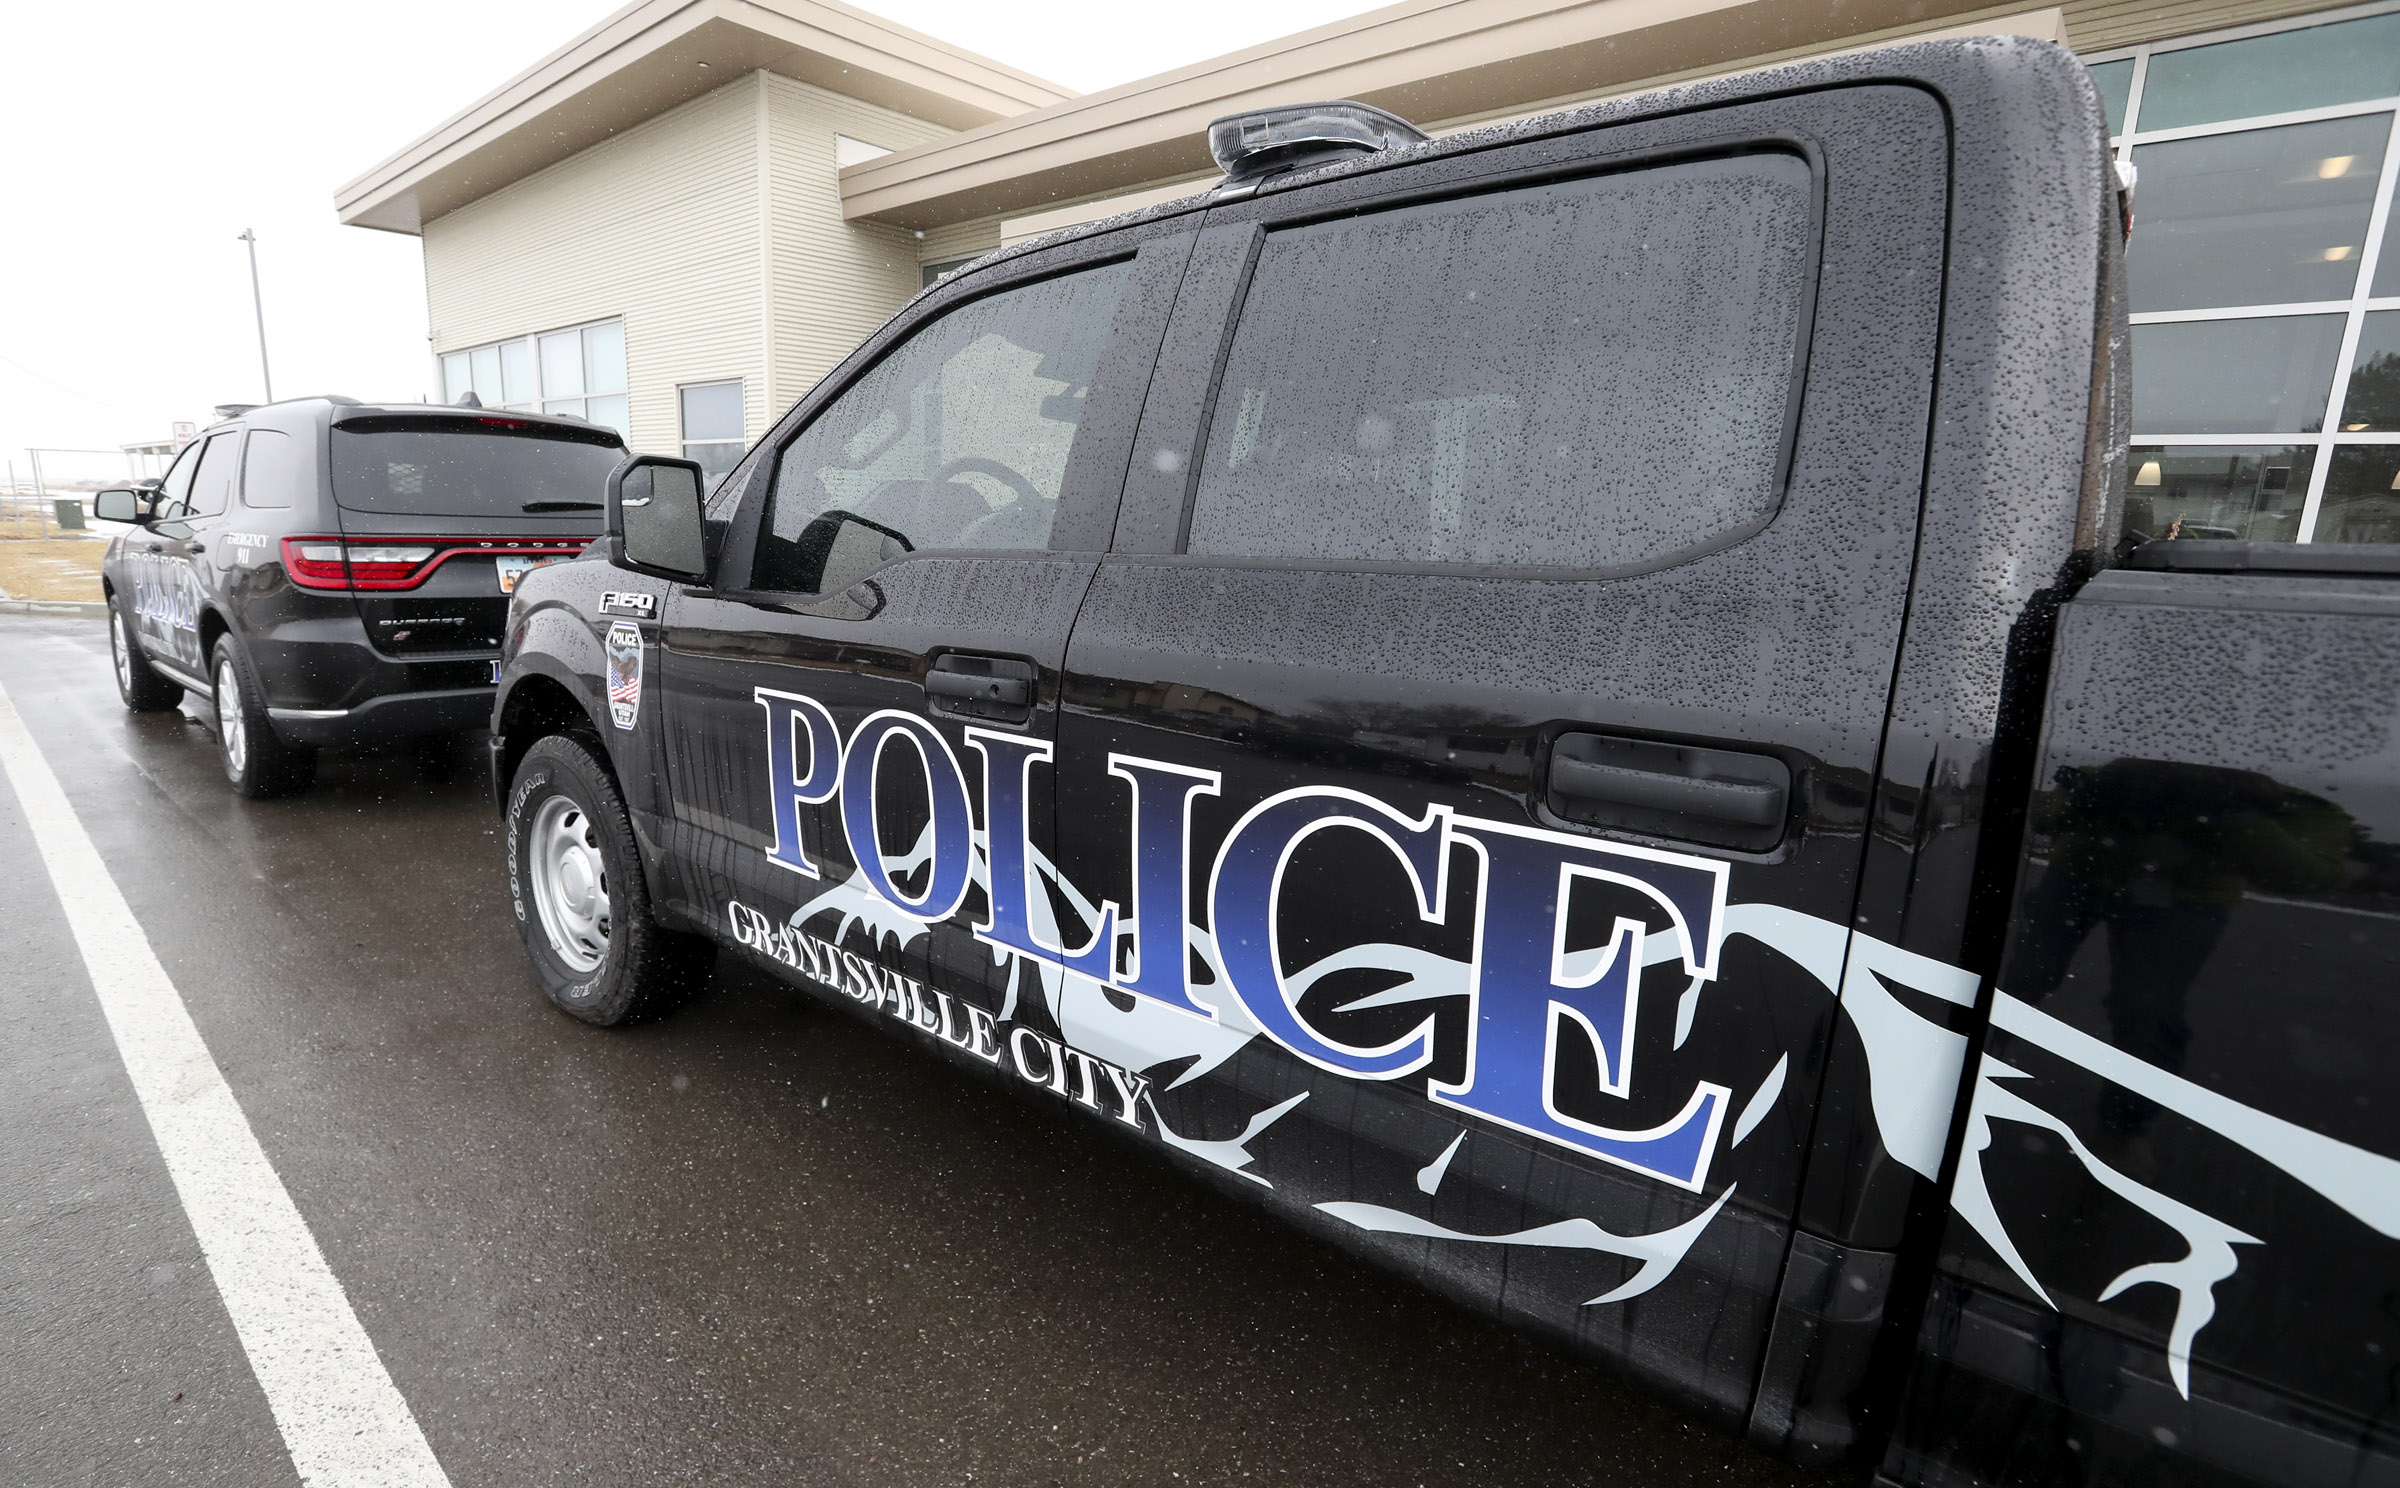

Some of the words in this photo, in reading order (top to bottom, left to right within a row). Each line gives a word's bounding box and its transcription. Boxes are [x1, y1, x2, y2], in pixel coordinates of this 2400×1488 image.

[226, 532, 269, 547] EMERGENCY
[237, 548, 250, 564] 911
[131, 552, 197, 632] POLICE
[612, 631, 638, 646] POLICE
[507, 772, 546, 921] GOODYEAR
[754, 686, 1732, 1195] POLICE
[728, 900, 1004, 1066] GRANTSVILLE
[1010, 1025, 1152, 1134] CITY
